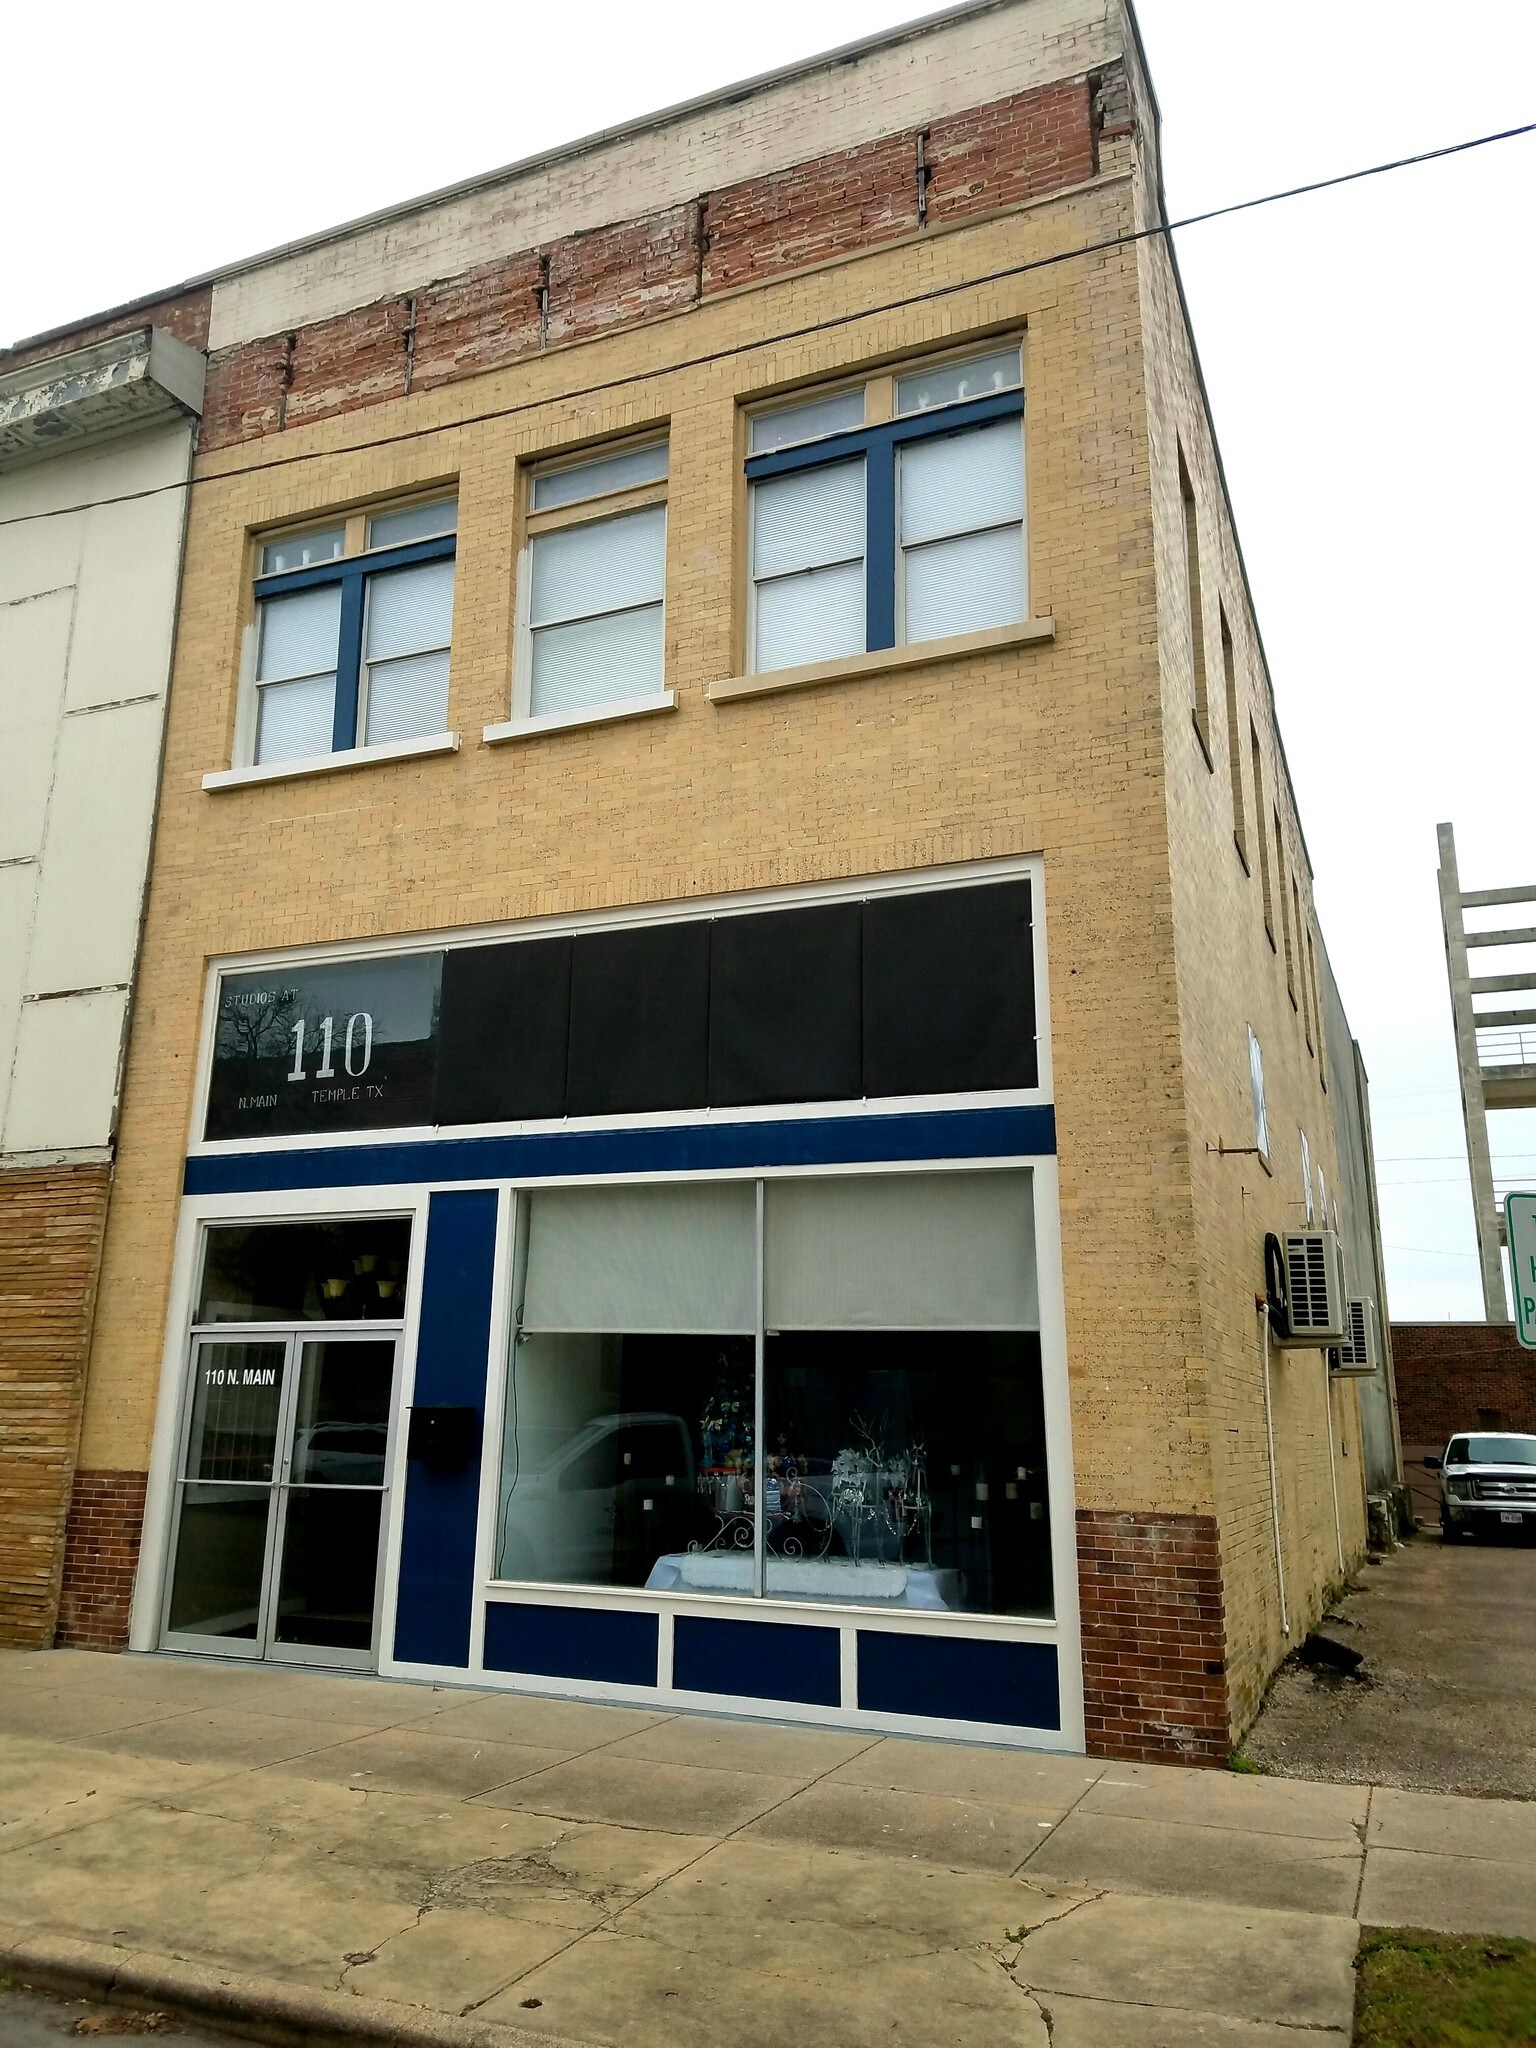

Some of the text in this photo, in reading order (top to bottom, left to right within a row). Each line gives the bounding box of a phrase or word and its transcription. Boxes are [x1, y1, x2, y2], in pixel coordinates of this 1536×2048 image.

[281, 988, 299, 1001] AT
[287, 1012, 373, 1082] 110
[312, 1084, 384, 1103] TEMPLE TX
[205, 1369, 275, 1385] 110 N. MAIN
